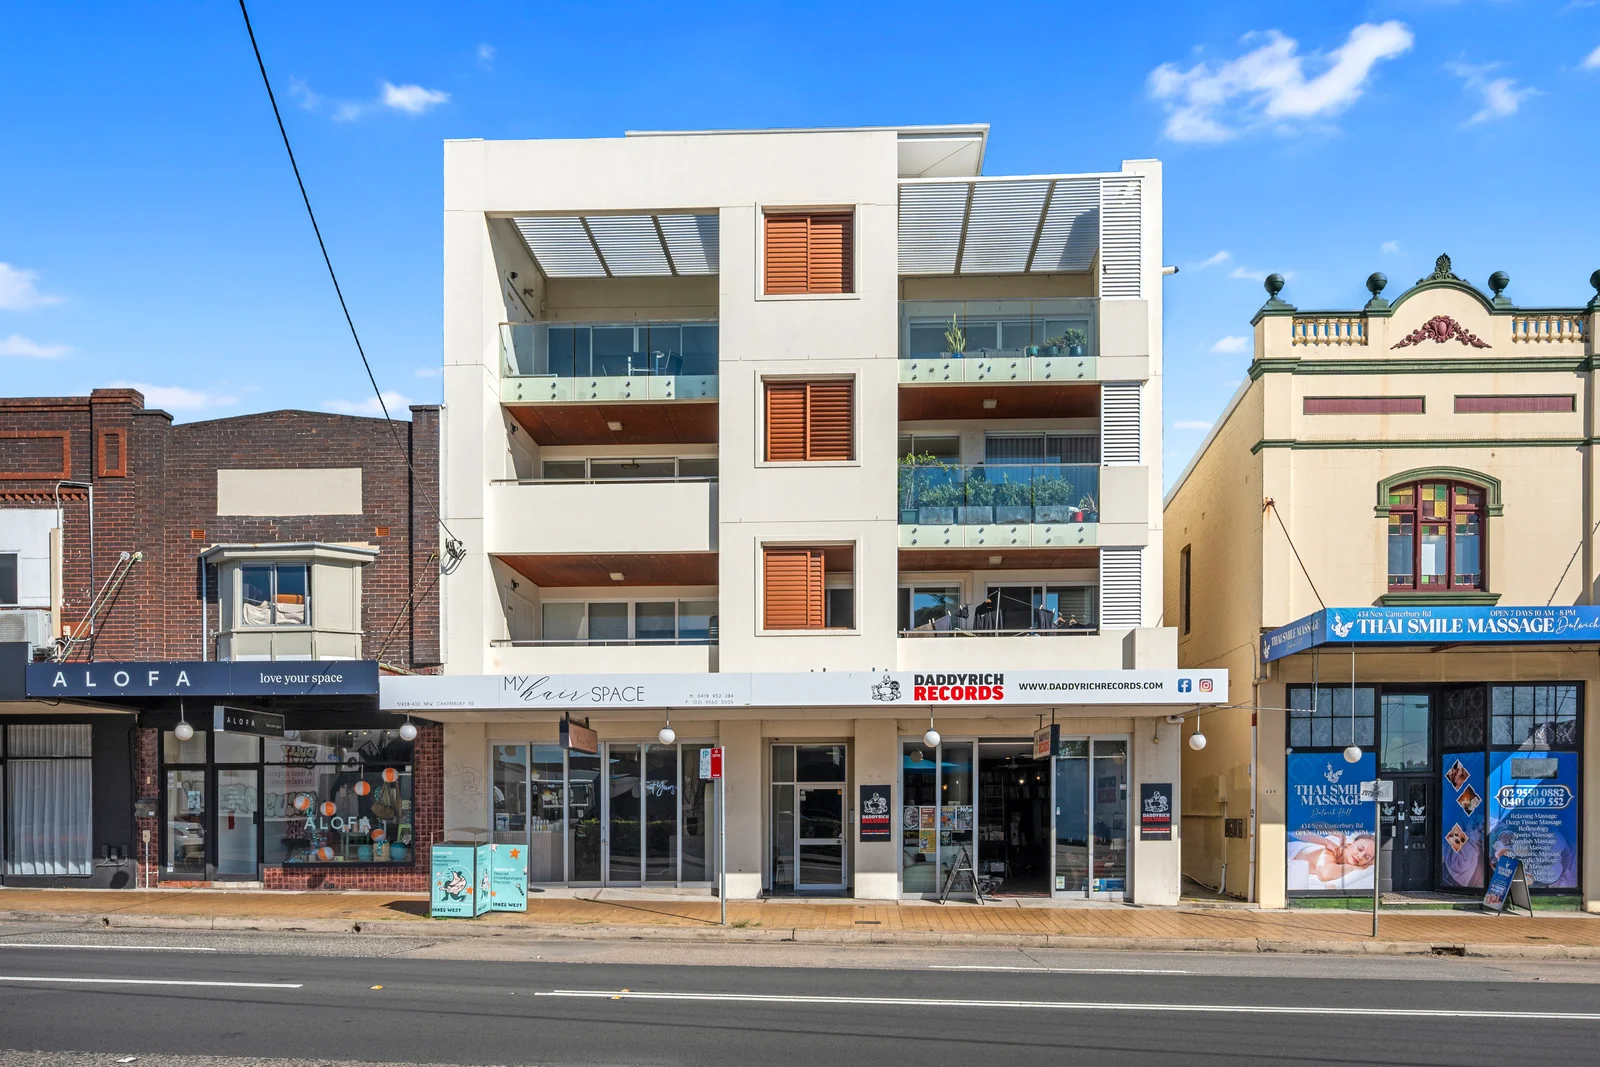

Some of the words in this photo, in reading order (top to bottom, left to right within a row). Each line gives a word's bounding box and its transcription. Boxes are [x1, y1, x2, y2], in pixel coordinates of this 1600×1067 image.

[1356, 619, 1402, 634] THAI
[1408, 618, 1463, 634] SMILE
[1467, 618, 1554, 633] MASSAGE
[1271, 633, 1283, 646] THAI
[1282, 628, 1296, 643] SMILE
[52, 670, 190, 687] ALOFA
[260, 673, 282, 683] love
[284, 674, 310, 684] your
[312, 674, 342, 684] space
[914, 673, 1004, 686] DADDYRICH
[504, 676, 528, 691] MY
[520, 676, 590, 700] hair
[591, 686, 644, 702] SPACE
[1018, 682, 1164, 690] WWW.DADDYRICHRECORDS.COM
[914, 686, 1004, 700] RECORDS
[226, 716, 256, 727] ALOFA
[1294, 784, 1326, 795] THAI
[1330, 784, 1360, 795] SMIL
[1502, 788, 1514, 797] 02
[1516, 788, 1538, 797] 9550
[1542, 788, 1564, 797] 0882
[1301, 796, 1362, 806] MASSAGE
[1502, 798, 1525, 806] 0401
[1528, 798, 1546, 806] 609
[1548, 798, 1564, 806] 552
[304, 816, 372, 830] ALOFA
